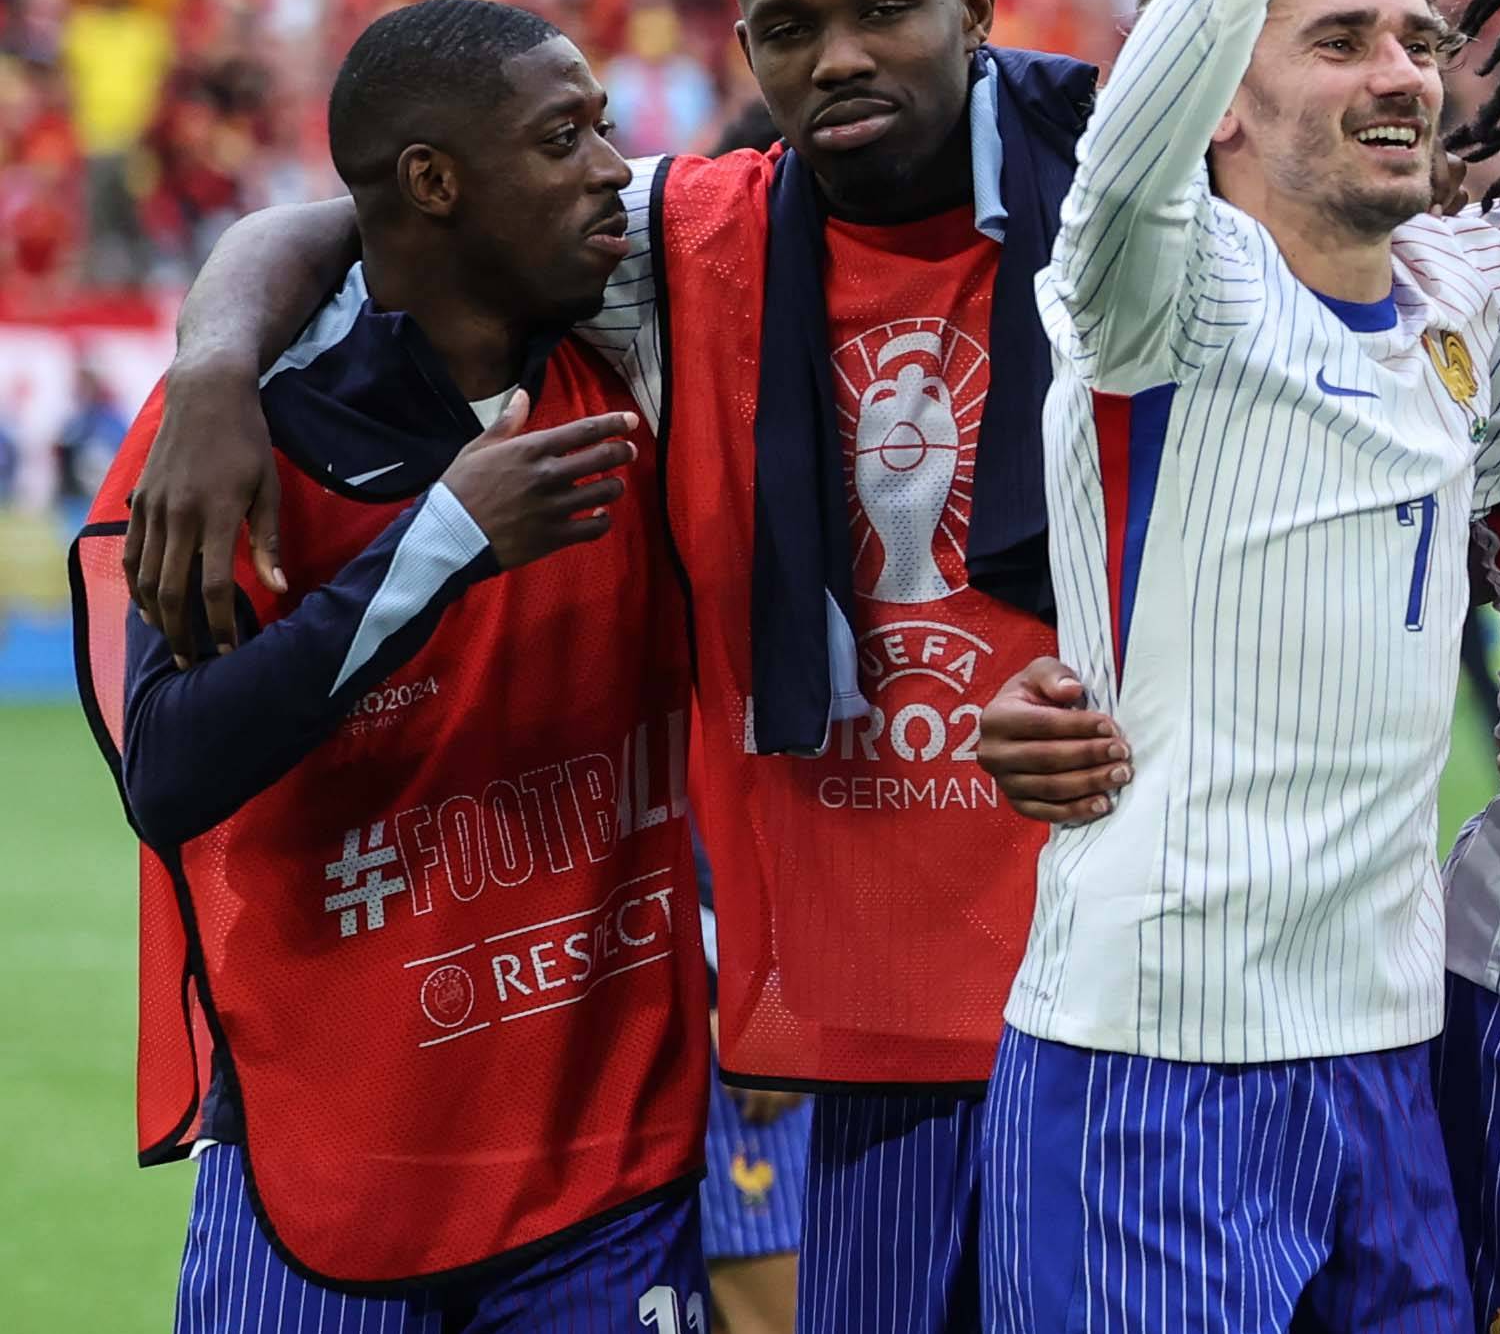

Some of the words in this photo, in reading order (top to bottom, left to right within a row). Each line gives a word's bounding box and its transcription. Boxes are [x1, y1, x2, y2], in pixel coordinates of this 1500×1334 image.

[1396, 492, 1440, 632] 7
[863, 633, 977, 684] UEFA
[817, 776, 999, 810] GERMAN
[491, 887, 675, 1003] RESECT
